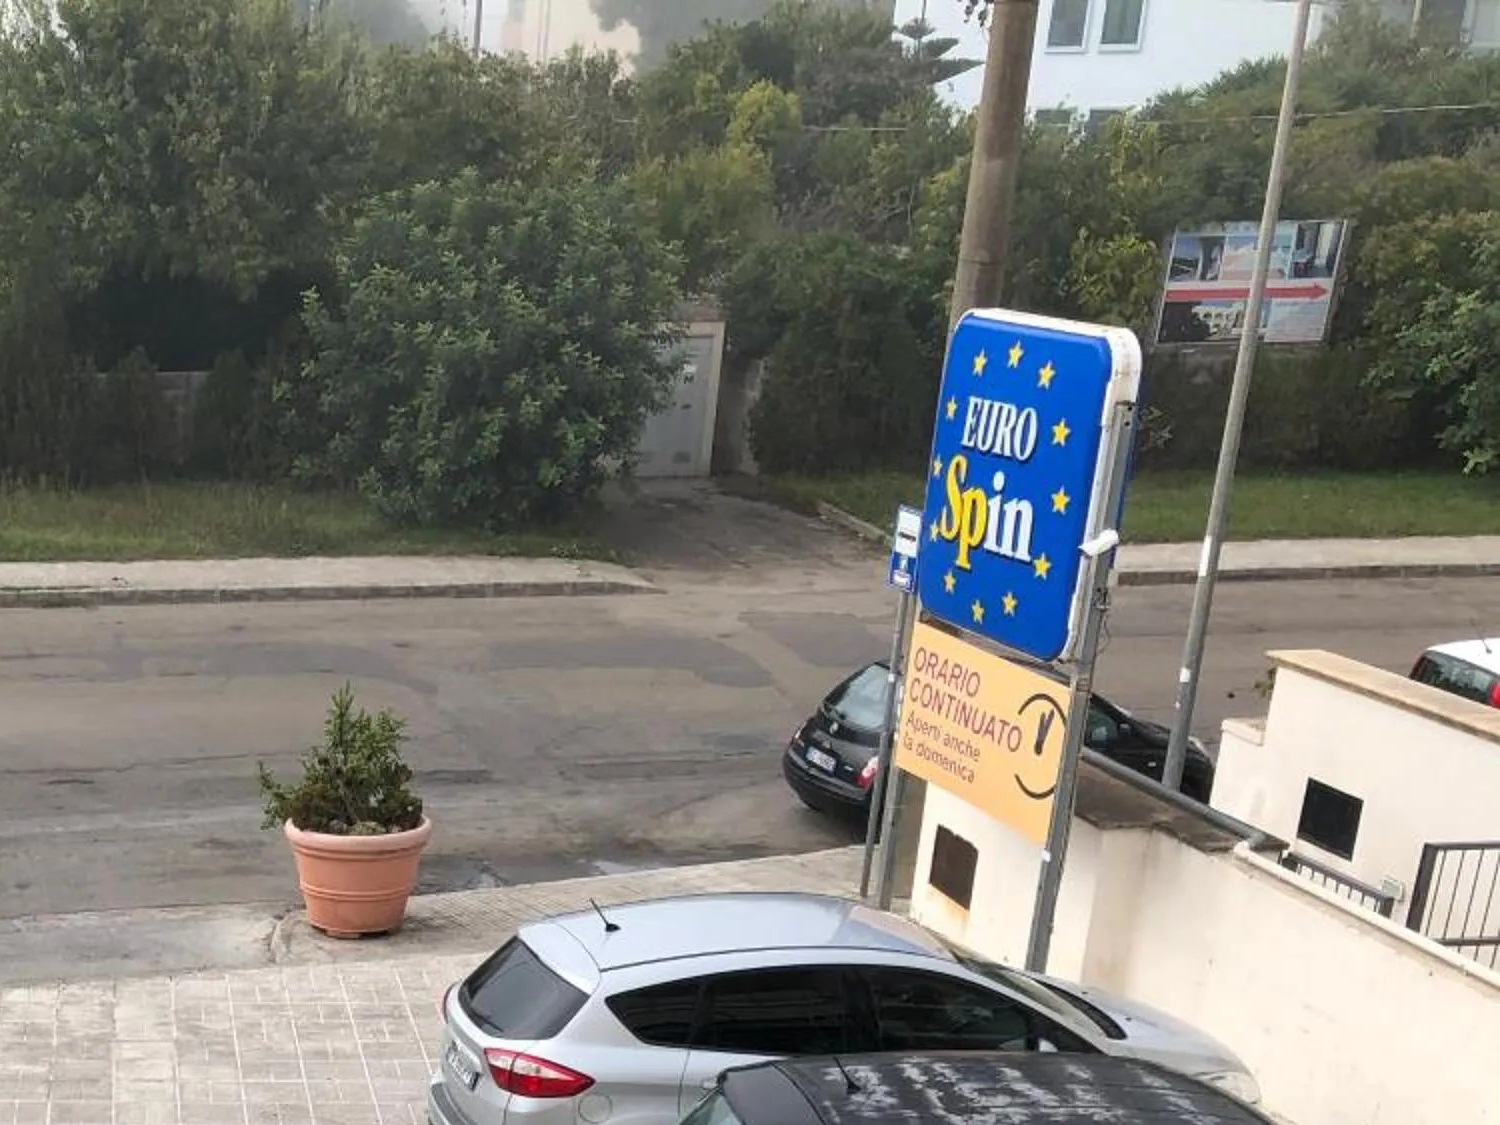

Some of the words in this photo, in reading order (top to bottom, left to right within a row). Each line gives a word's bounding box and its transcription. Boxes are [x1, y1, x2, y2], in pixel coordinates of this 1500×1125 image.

[961, 396, 1038, 461] EURO
[940, 455, 1033, 570] Spin
[914, 647, 981, 698] ORARIO
[909, 677, 1023, 753] CONTINUATO
[915, 743, 975, 783] domenica
[943, 732, 981, 763] anche
